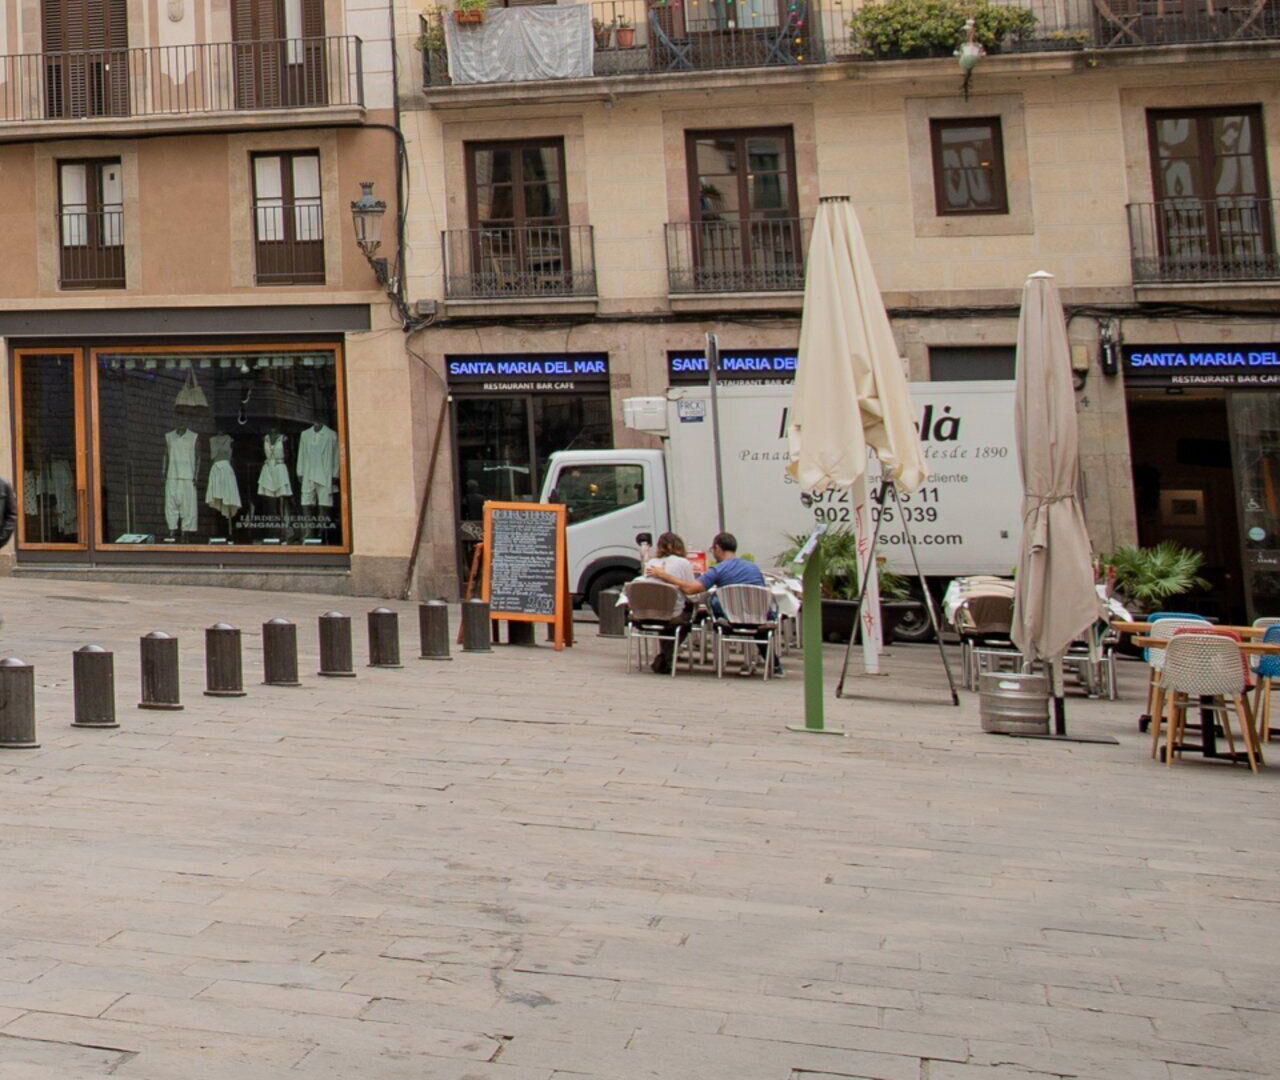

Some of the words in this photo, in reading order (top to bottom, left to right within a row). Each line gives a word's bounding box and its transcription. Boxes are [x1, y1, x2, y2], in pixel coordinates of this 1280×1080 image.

[672, 358, 721, 371] SANT
[724, 358, 771, 370] MARIA
[1131, 353, 1187, 366] SANTA
[1189, 353, 1245, 366] MARIA
[1248, 352, 1280, 365] DEL
[450, 362, 495, 374] SANTA
[497, 362, 541, 374] MARIA
[544, 361, 571, 373] DEL
[574, 360, 605, 373] MAR
[1260, 375, 1280, 383] CAF
[975, 446, 1008, 458] 1890
[927, 473, 968, 483] cliente
[812, 488, 849, 503] 972
[920, 487, 939, 502] 11
[814, 507, 850, 522] 902
